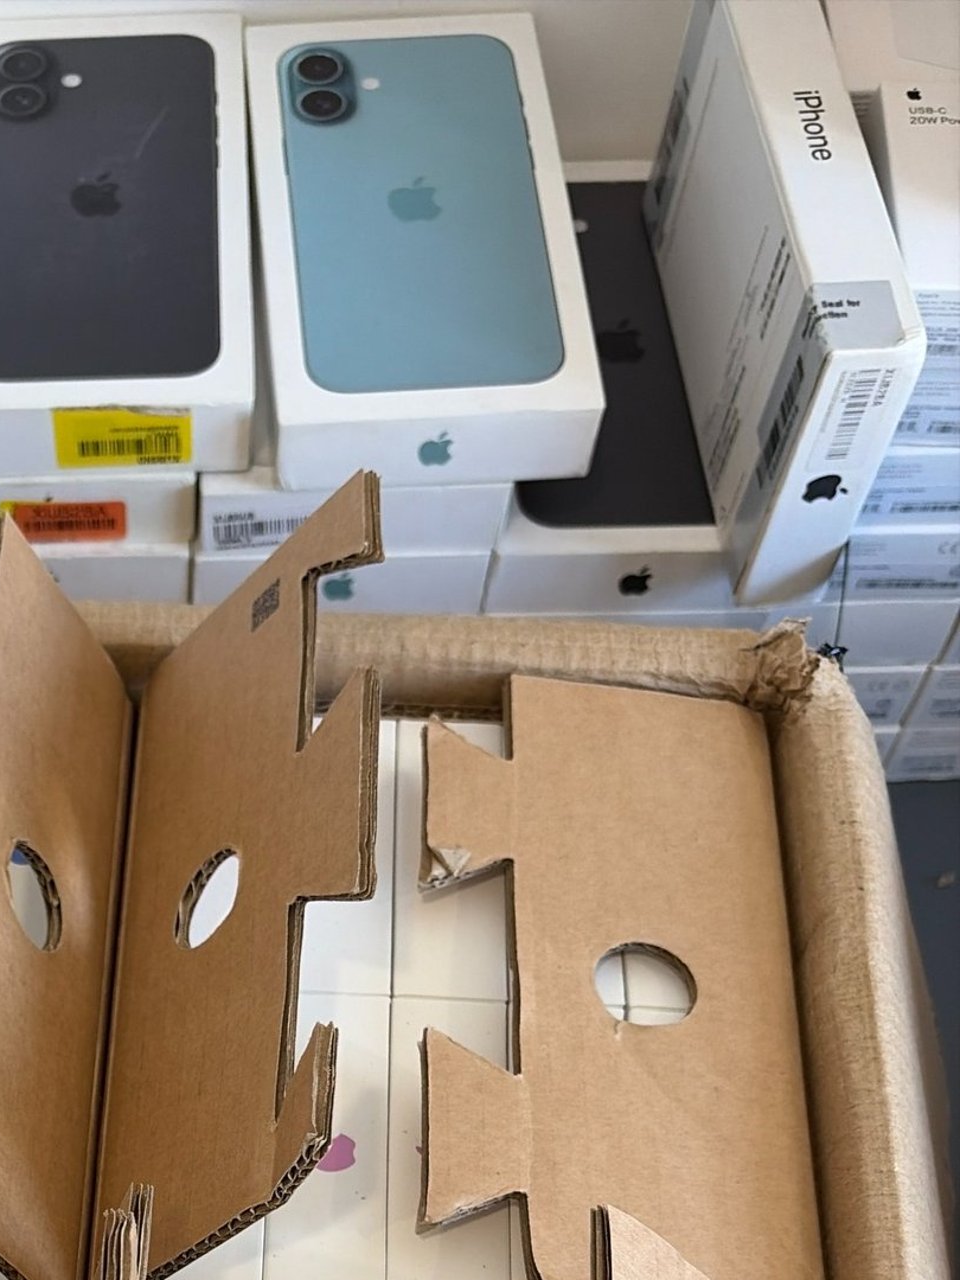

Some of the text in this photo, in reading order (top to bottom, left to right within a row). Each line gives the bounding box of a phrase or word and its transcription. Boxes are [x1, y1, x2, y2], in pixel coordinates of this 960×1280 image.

[908, 106, 947, 115] USB-C
[910, 116, 938, 125] 20W
[793, 90, 832, 161] iPhone
